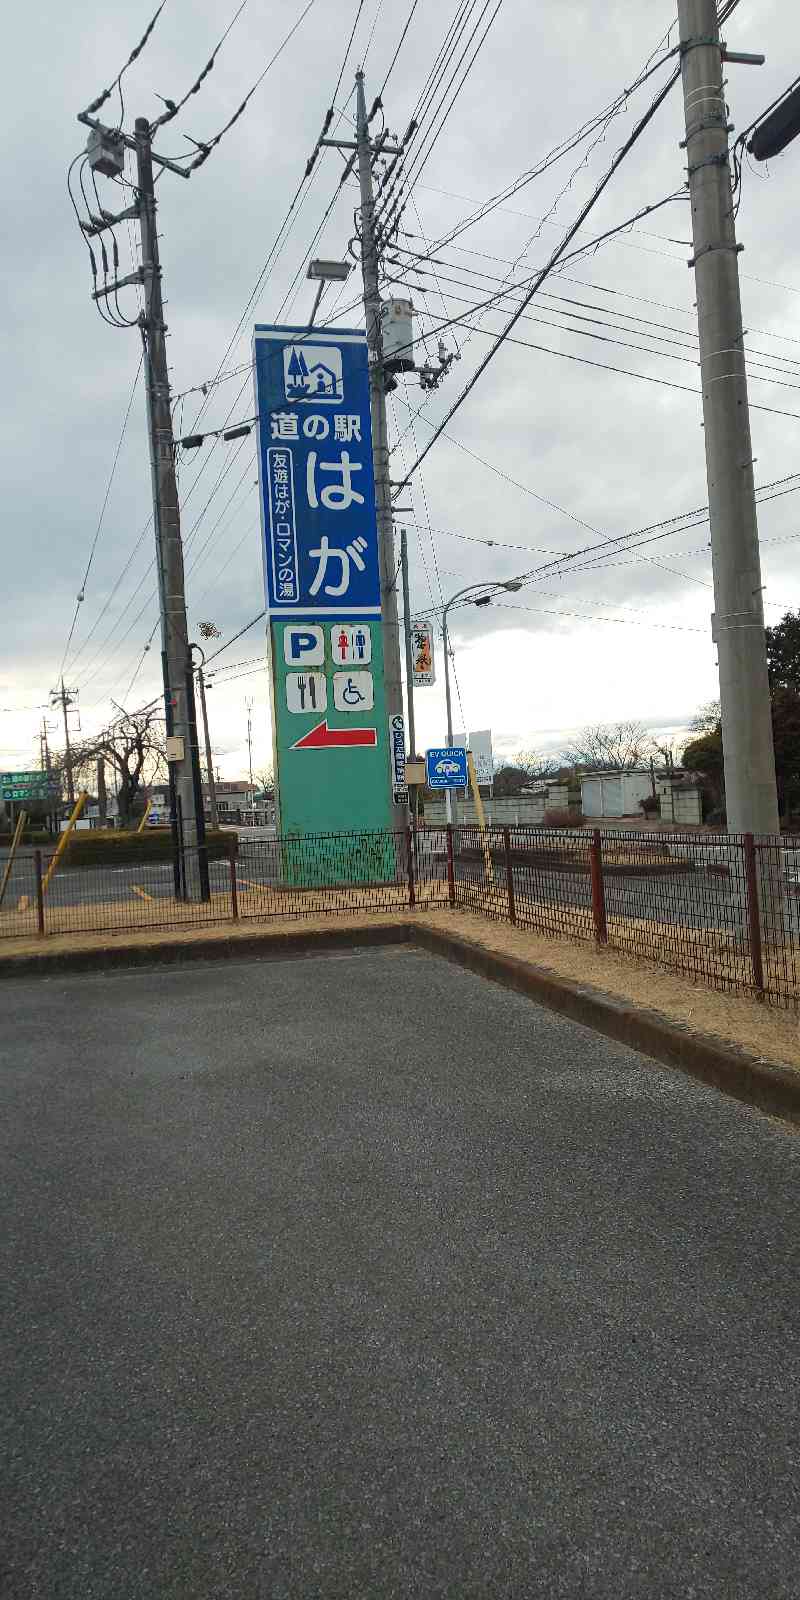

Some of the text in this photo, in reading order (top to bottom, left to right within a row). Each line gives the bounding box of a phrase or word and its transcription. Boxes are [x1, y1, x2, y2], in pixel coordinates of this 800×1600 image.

[270, 412, 362, 442] 道の駅
[306, 450, 368, 597] はが
[290, 632, 318, 659] P
